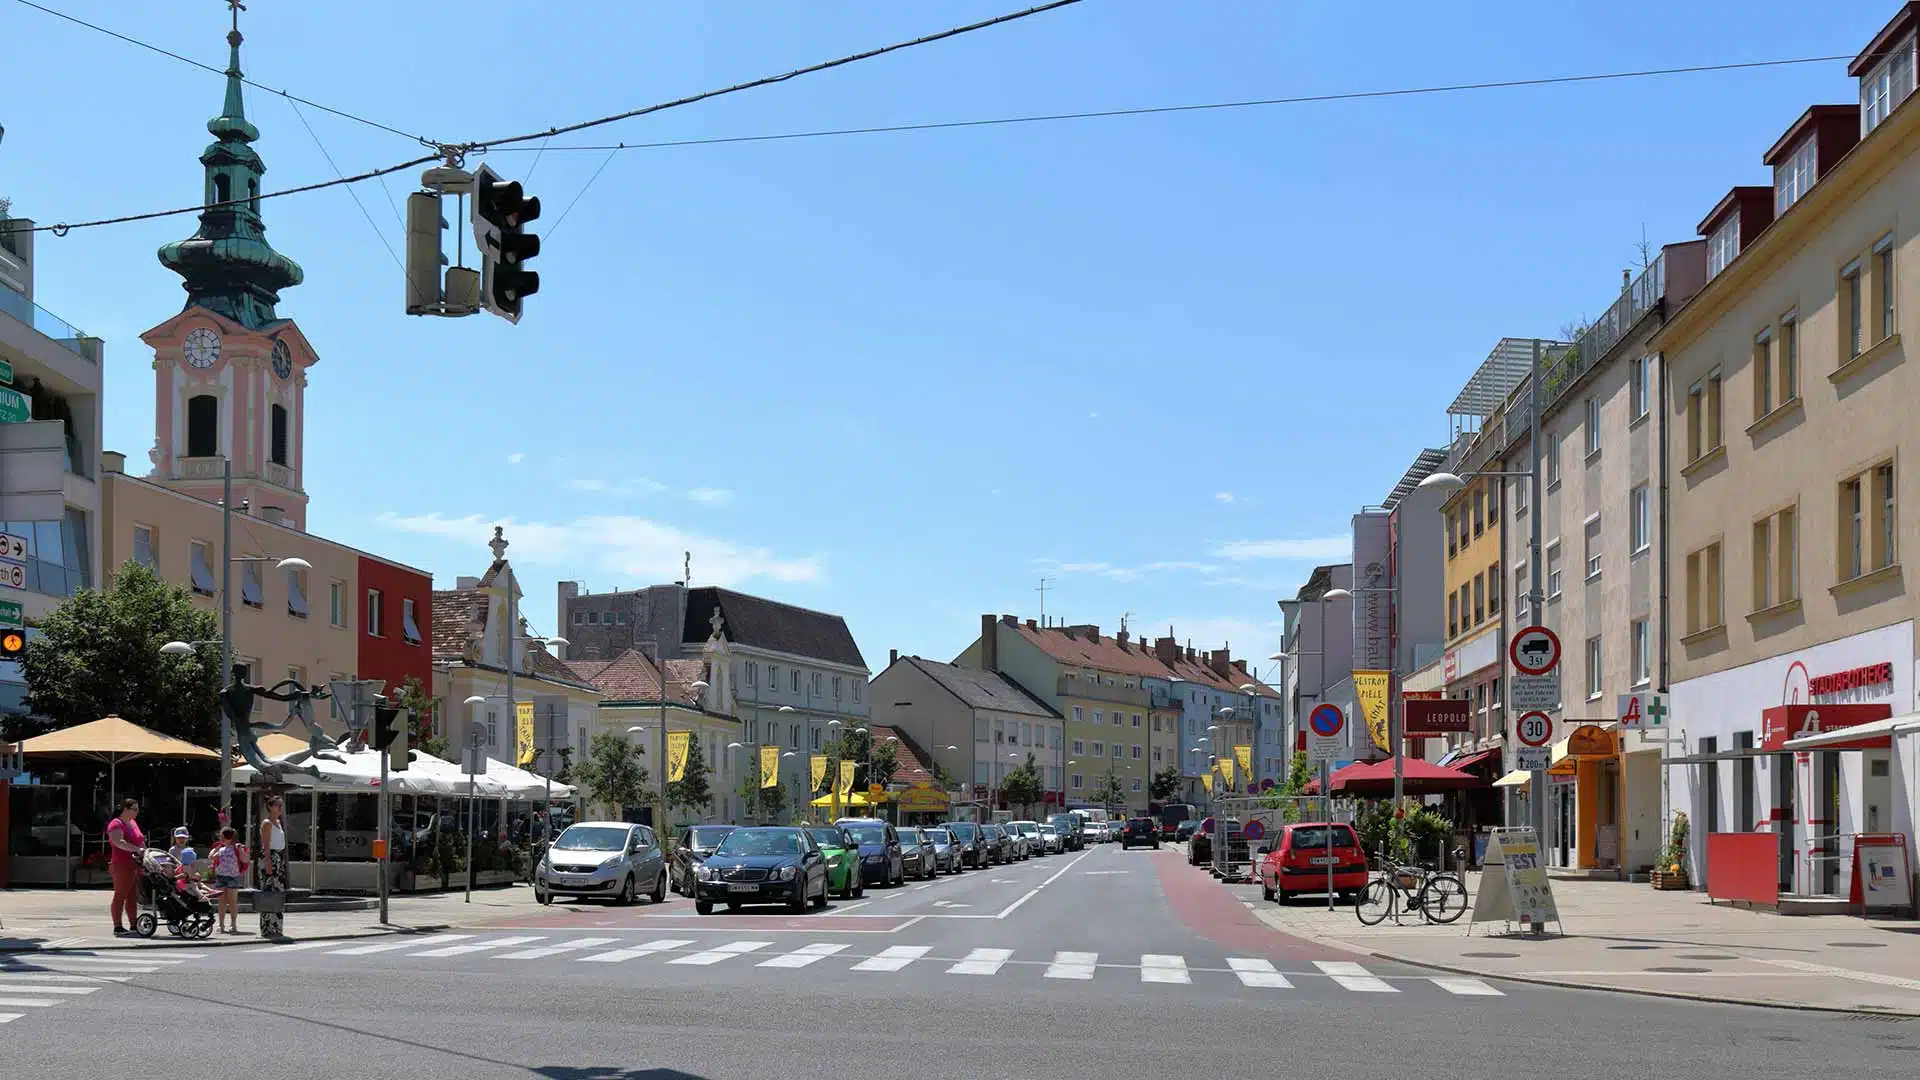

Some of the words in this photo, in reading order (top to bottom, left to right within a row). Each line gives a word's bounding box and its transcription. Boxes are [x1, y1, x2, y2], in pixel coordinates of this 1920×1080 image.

[1808, 661, 1890, 696] STADTAPOTHEKE
[1426, 712, 1467, 723] LEOPOLD
[1526, 721, 1543, 737] 30
